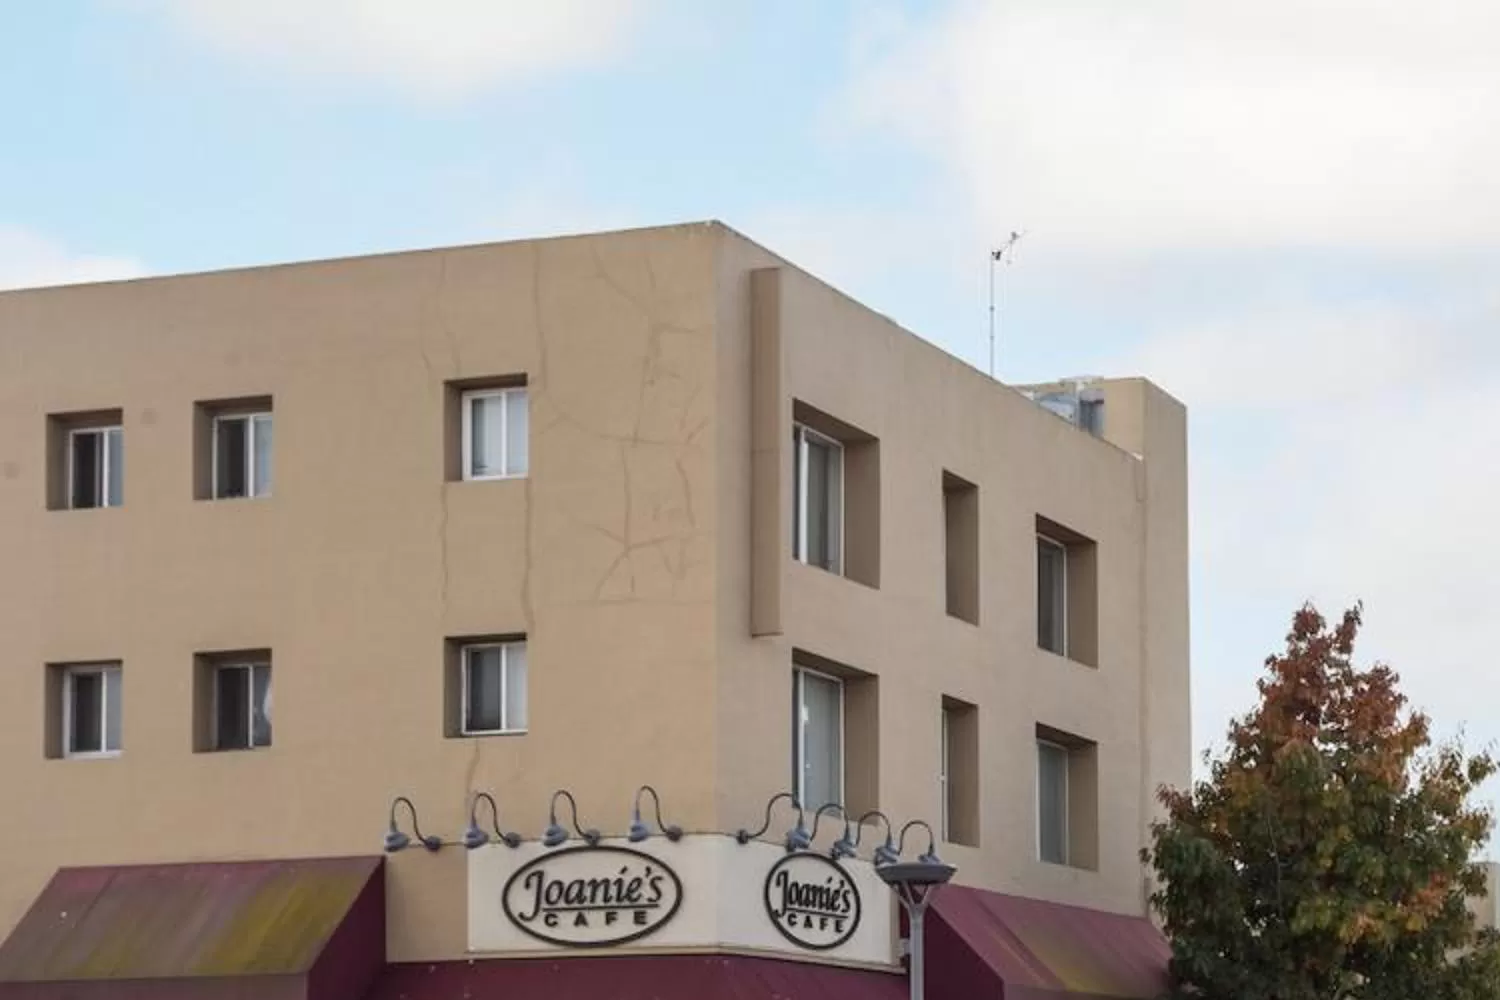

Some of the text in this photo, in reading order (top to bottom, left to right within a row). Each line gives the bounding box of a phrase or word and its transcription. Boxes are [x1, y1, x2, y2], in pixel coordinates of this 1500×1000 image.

[518, 866, 664, 922] Joanie's
[772, 870, 851, 918] Joanie's
[544, 911, 648, 927] CAFE
[787, 913, 844, 933] CAFE
